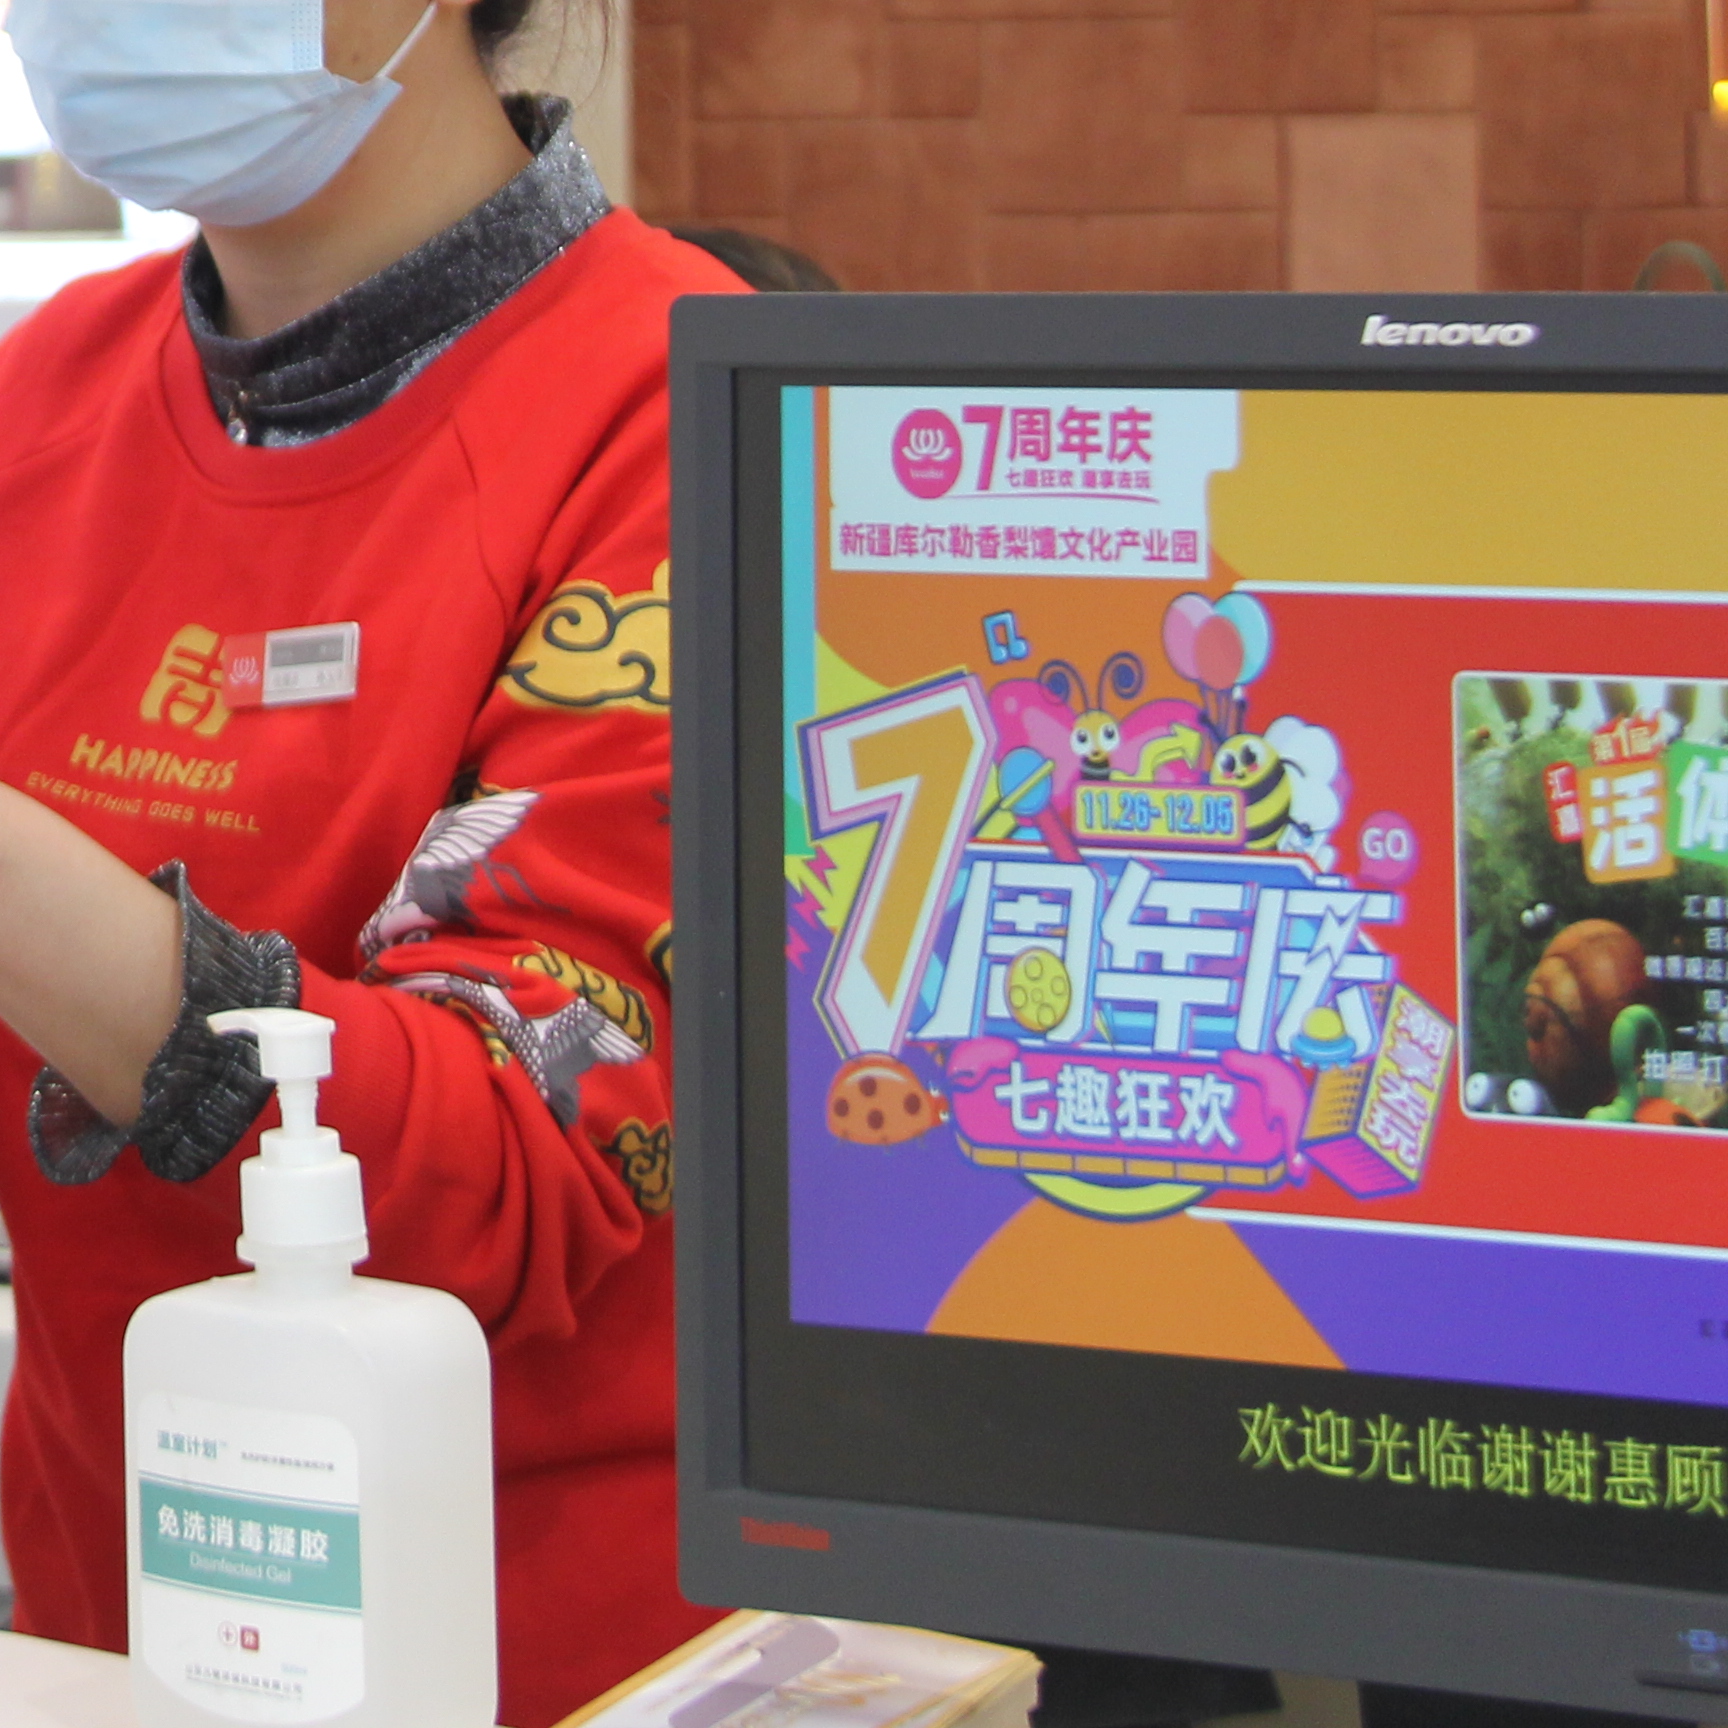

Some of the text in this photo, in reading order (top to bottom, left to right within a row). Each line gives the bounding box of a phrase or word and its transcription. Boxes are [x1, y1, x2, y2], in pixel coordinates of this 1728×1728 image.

[1360, 314, 1540, 346] lenovo
[962, 404, 1153, 491] 7周年庆
[840, 522, 1198, 565] 新疆库尔勒香梨馕文化产业园
[70, 732, 239, 792] HAPPINESS
[25, 771, 261, 833] EVERYTHING GOES WELL
[1082, 790, 1234, 834] 11.26-12.05
[804, 674, 1392, 1060] 7周年庆
[1362, 827, 1410, 862] GO
[994, 1060, 1238, 1147] 七趣狂欢
[1238, 1402, 1728, 1518] 欢迎光临谢谢惠顾
[158, 1504, 329, 1562] 免洗消毒凝胶
